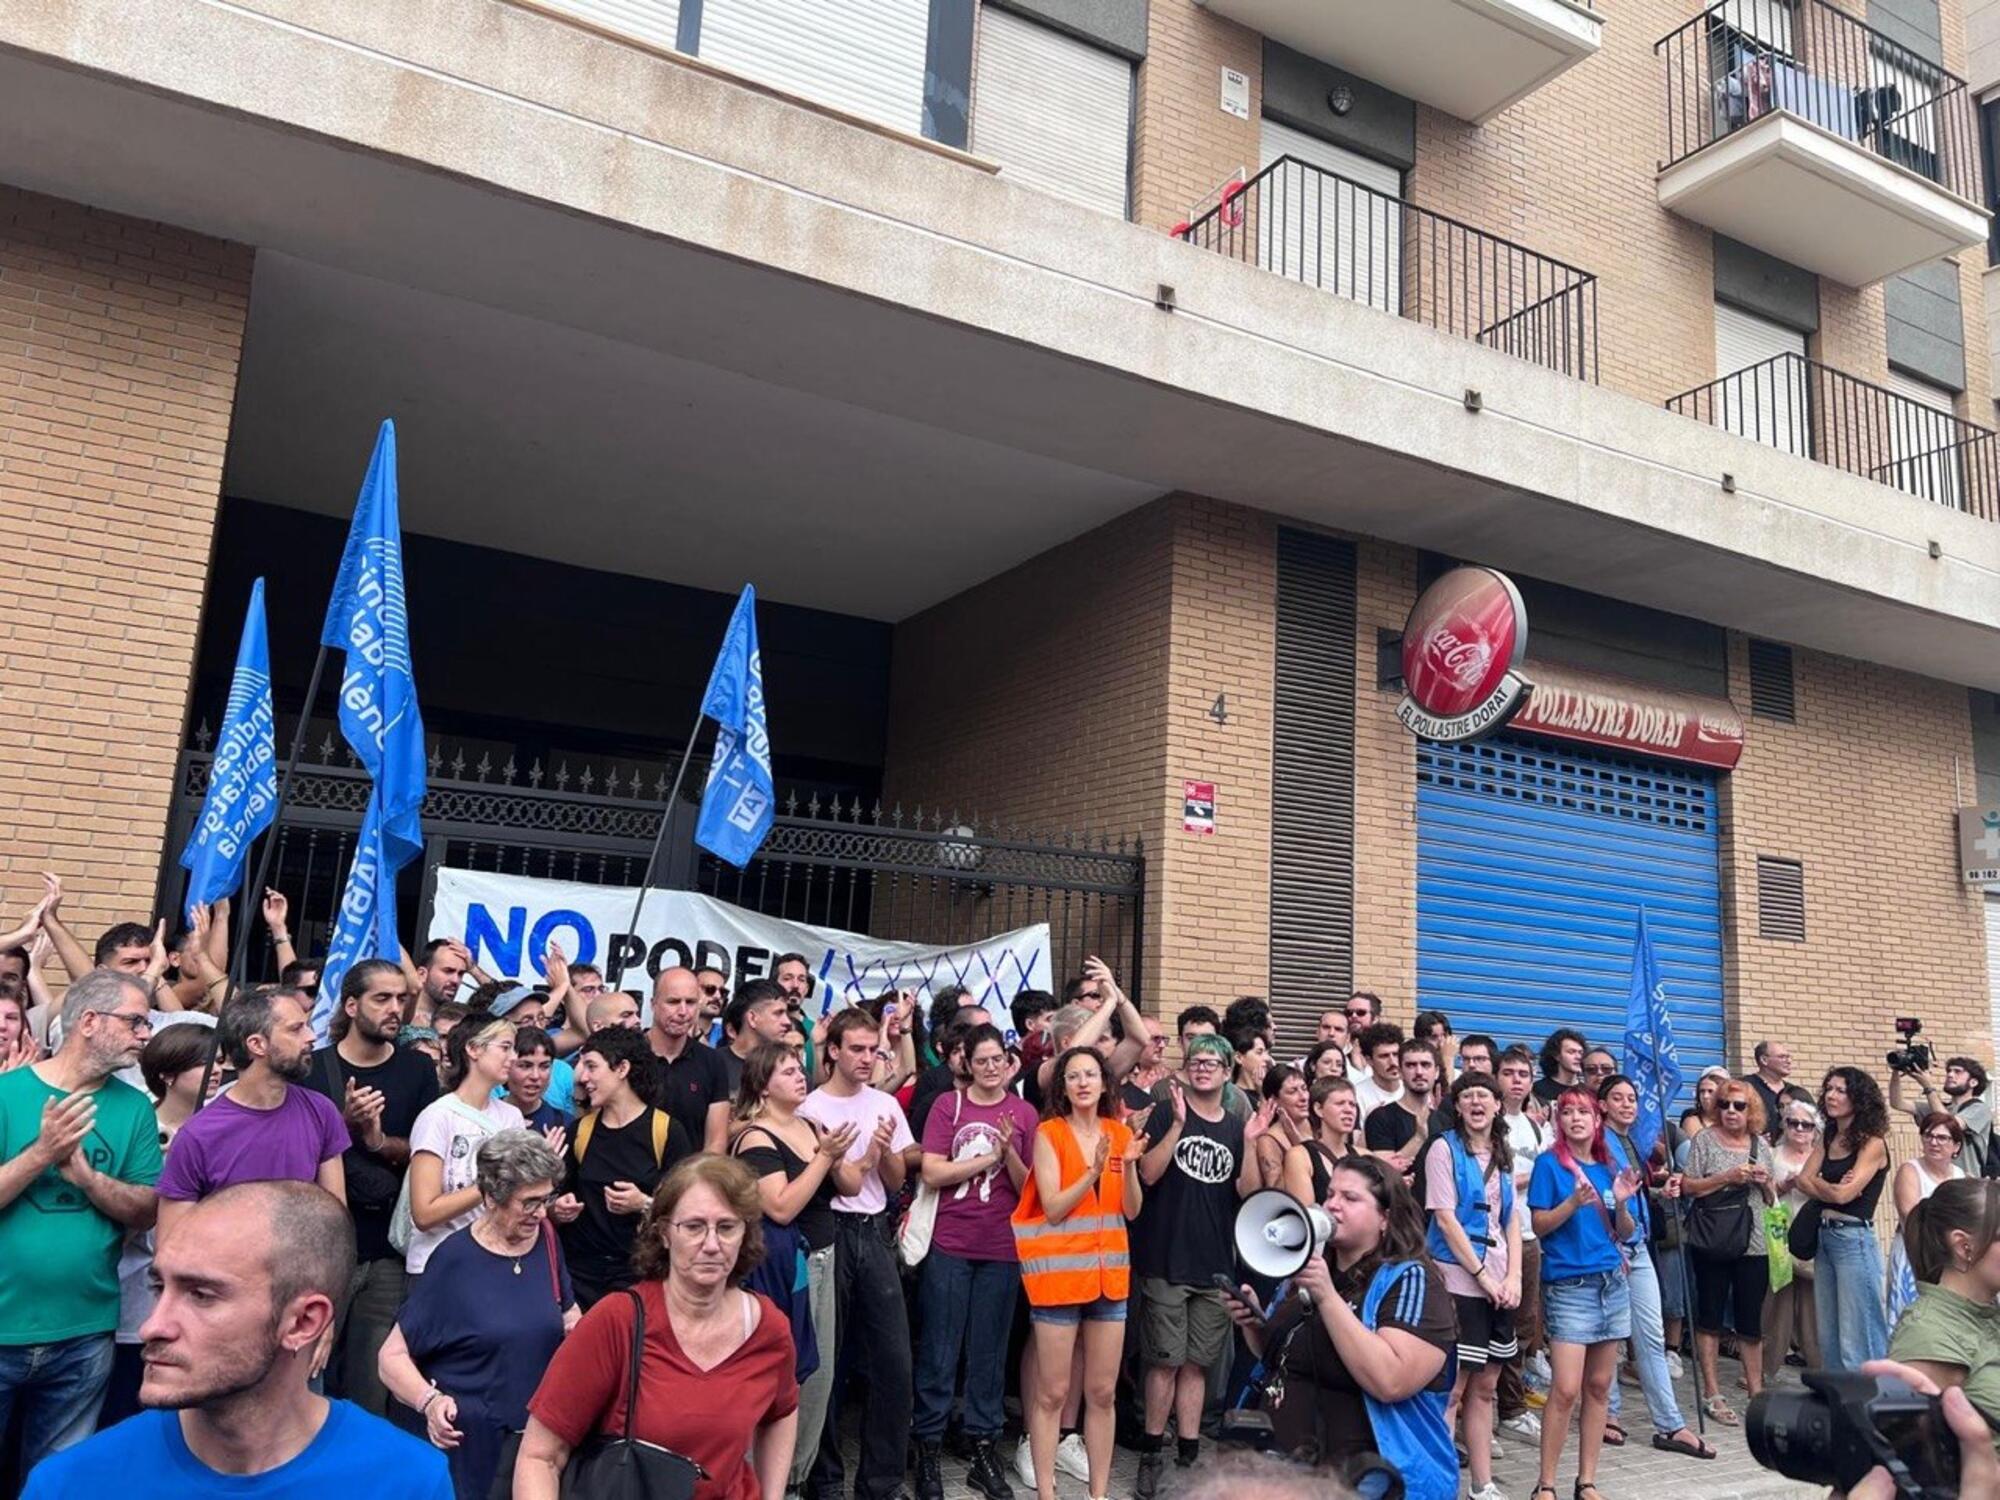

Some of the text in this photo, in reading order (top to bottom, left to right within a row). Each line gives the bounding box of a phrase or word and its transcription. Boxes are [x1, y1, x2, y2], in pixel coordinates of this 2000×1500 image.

[1209, 692, 1228, 724] 4
[1401, 688, 1508, 738] EL POLLASTRE DORAT
[1525, 686, 1688, 748] POLLASTRE DORAT
[465, 902, 782, 990] NO PODE
